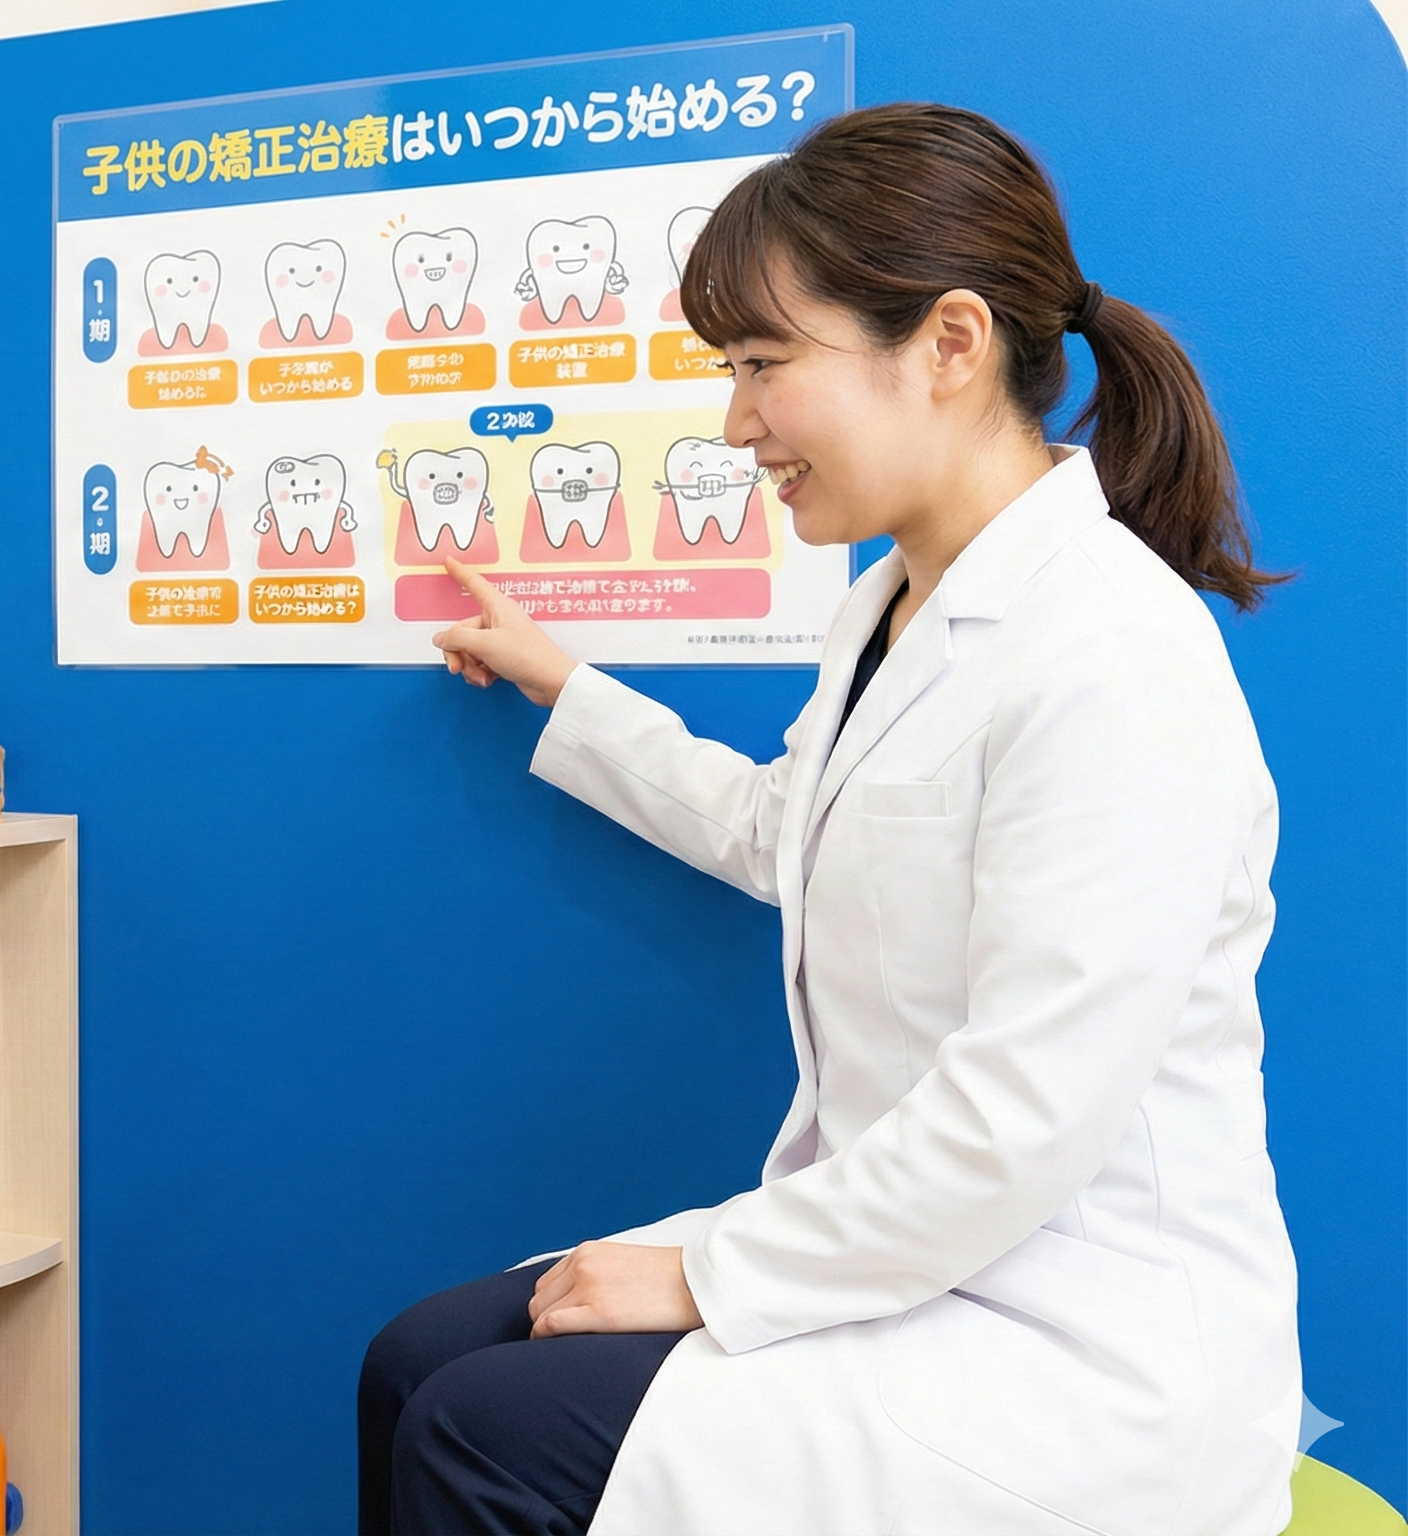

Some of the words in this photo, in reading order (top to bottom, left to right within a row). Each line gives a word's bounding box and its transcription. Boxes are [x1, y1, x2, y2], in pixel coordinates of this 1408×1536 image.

[83, 71, 817, 195] 子供の矯正治療はいつから始める？
